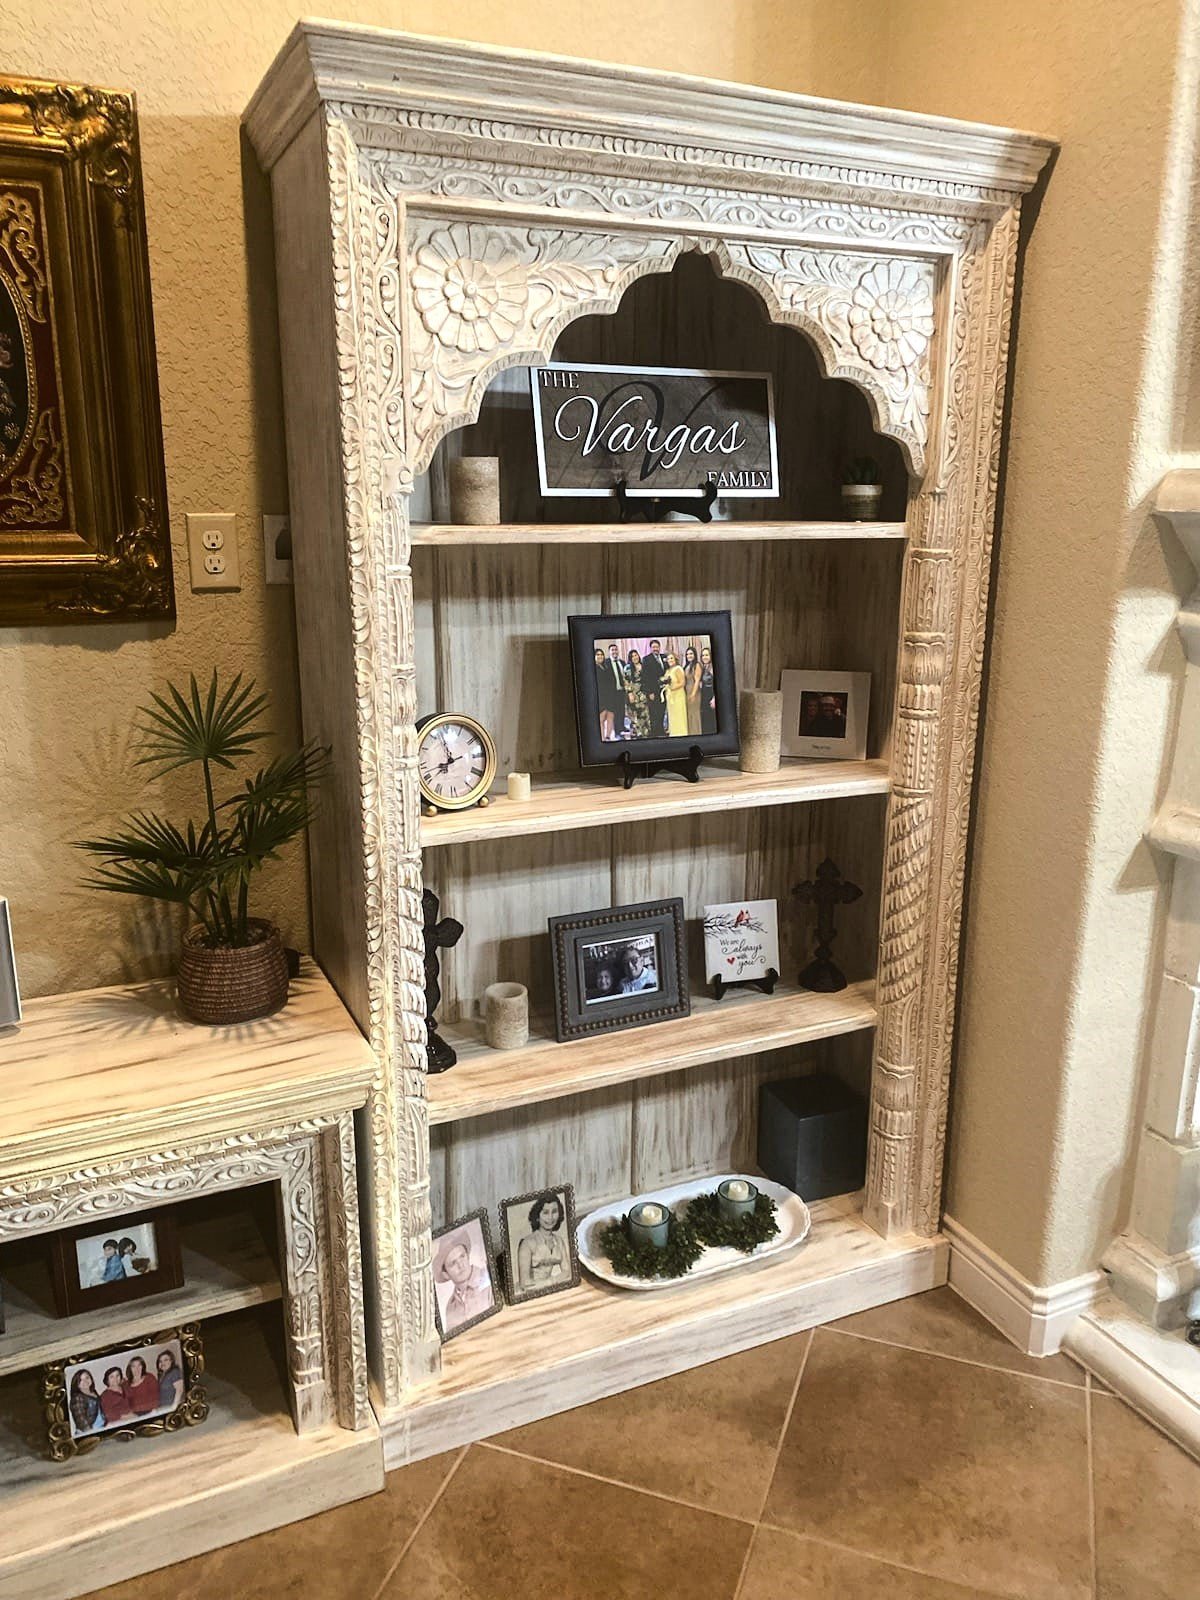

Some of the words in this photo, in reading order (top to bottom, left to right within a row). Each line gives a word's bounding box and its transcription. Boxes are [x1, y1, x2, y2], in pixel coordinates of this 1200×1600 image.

[539, 370, 580, 389] THE
[554, 395, 747, 470] Vargas
[706, 471, 770, 488] FAMILY
[722, 938, 762, 960] always
[737, 955, 767, 975] you
